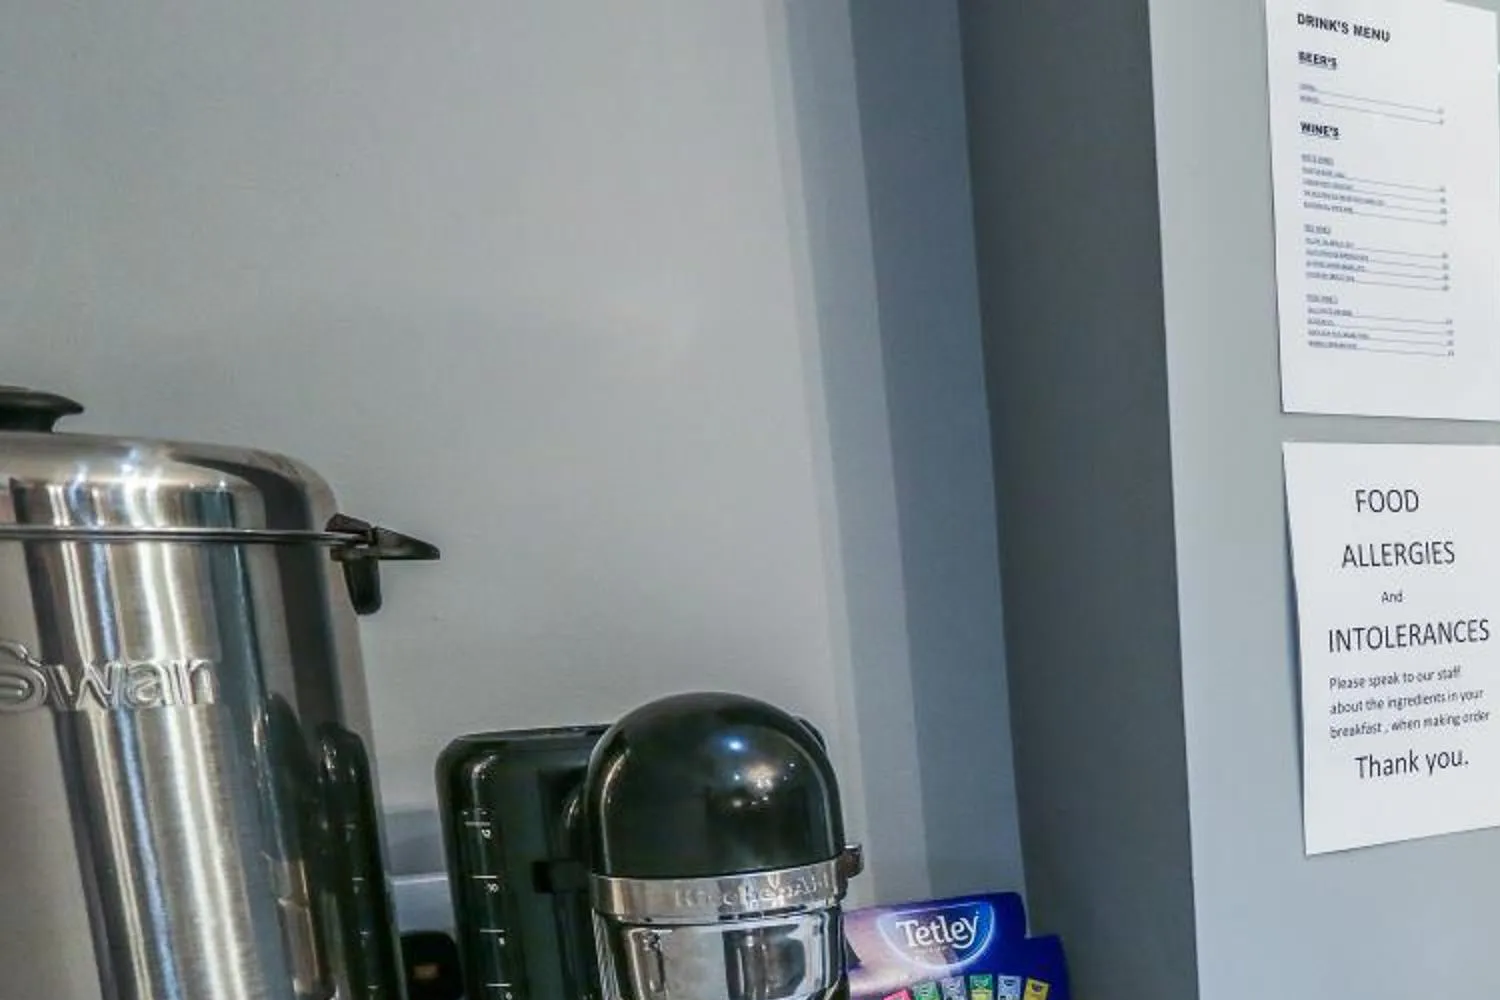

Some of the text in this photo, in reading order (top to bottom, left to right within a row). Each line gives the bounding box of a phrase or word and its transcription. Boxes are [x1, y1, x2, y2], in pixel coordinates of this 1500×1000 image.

[1297, 13, 1390, 42] DRINK'S MENU
[1298, 51, 1337, 70] BEER'S
[1299, 121, 1339, 140] WINE'S
[1354, 488, 1420, 514] FOOD
[1341, 540, 1456, 569] ALLERGIES
[1380, 590, 1403, 604] And
[1328, 617, 1491, 654] INTOLERANCES
[1329, 665, 1461, 691] Please speak to our staff
[1329, 689, 1485, 716] about the ingredients in your
[1391, 719, 1421, 731] when
[1423, 713, 1461, 728] making
[1461, 709, 1490, 724] order
[1353, 748, 1469, 780] Thank you.
[896, 911, 979, 949] Tetley
